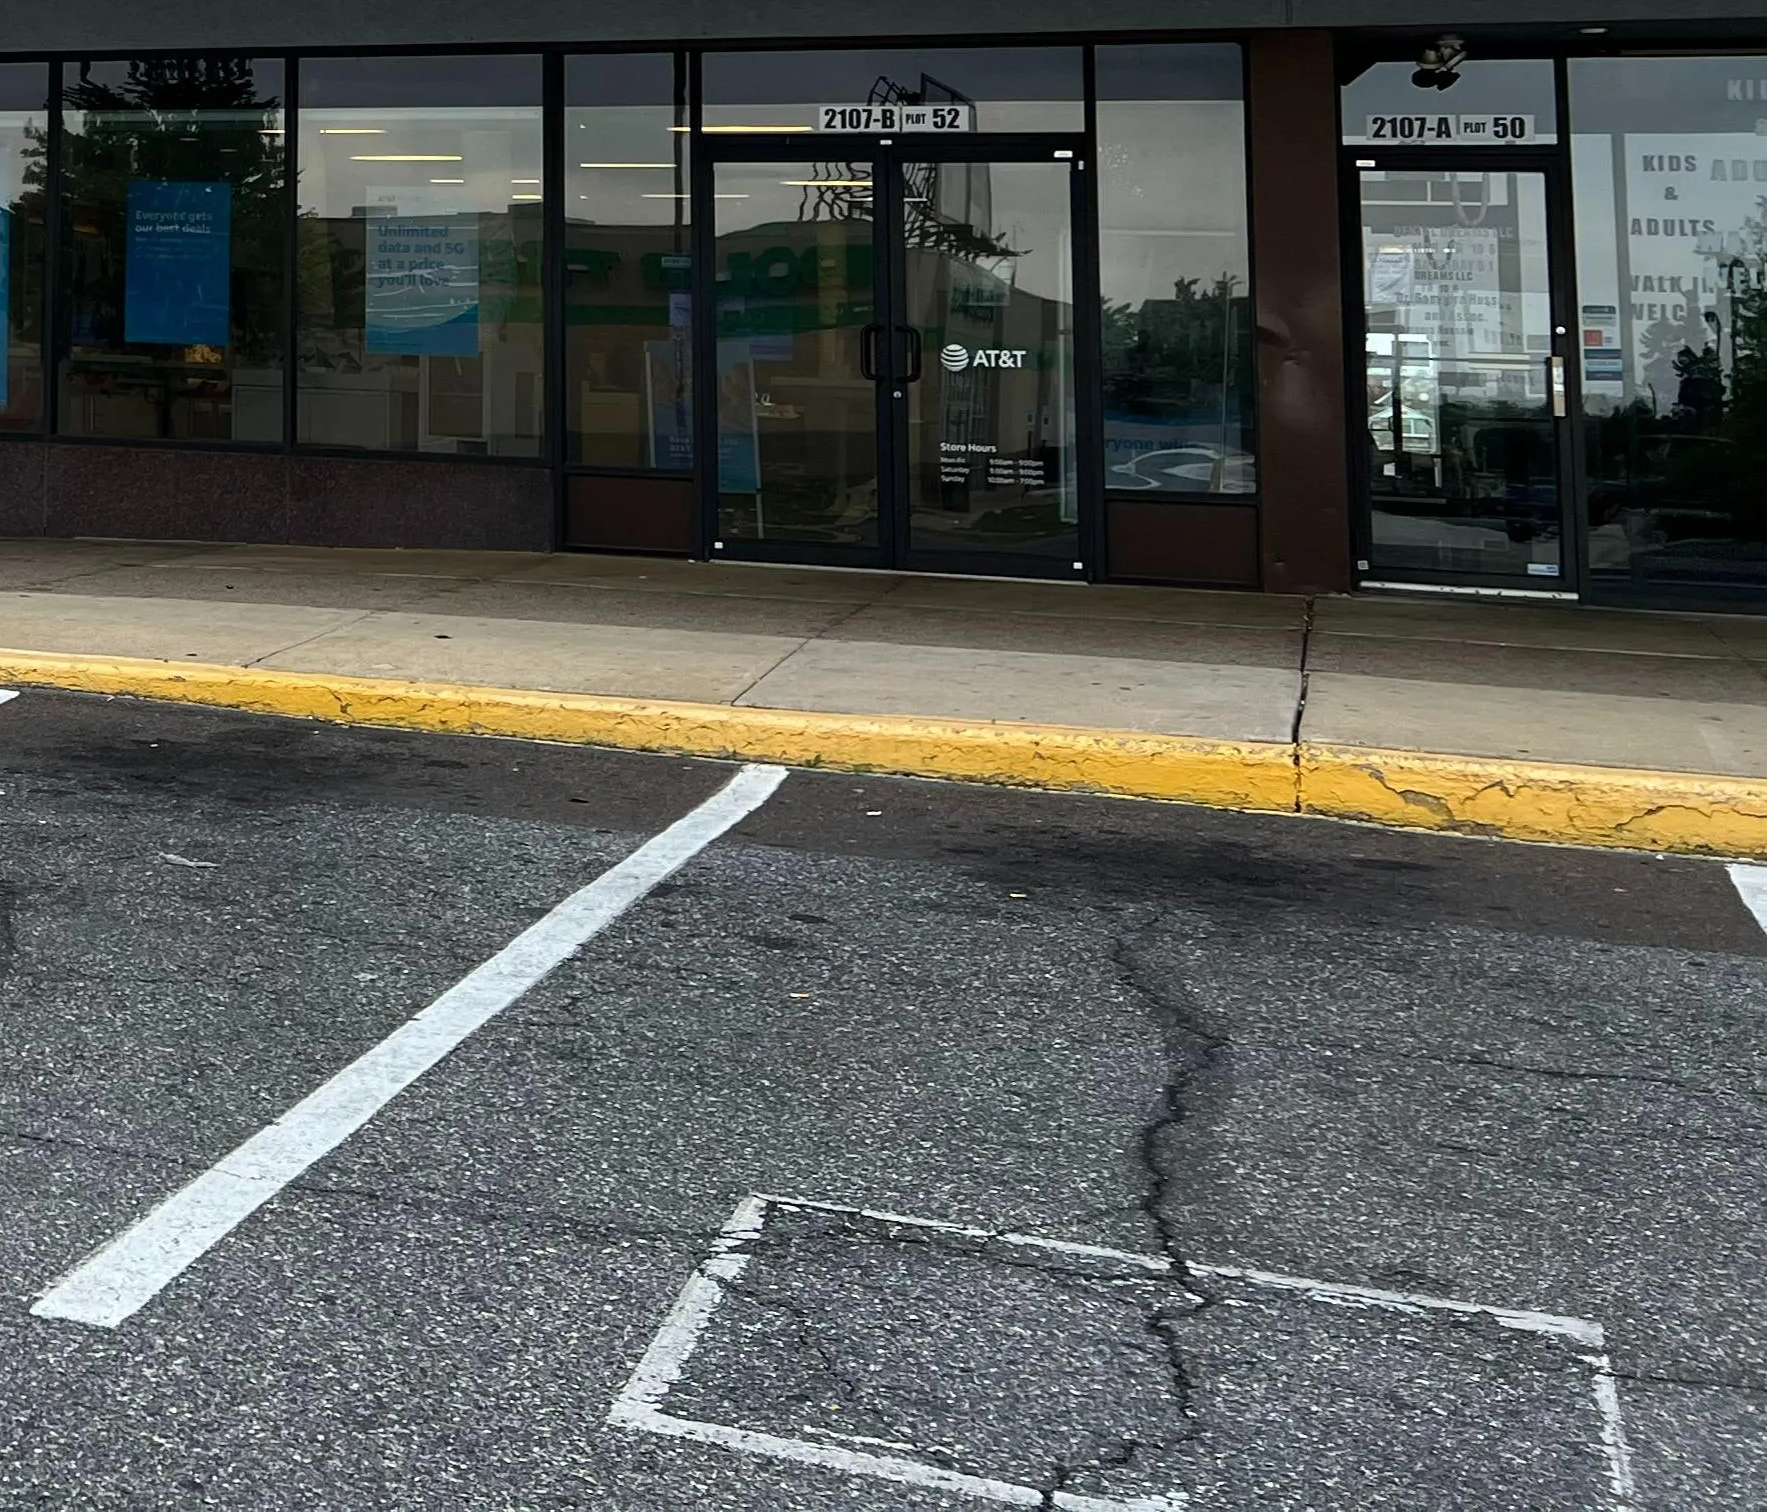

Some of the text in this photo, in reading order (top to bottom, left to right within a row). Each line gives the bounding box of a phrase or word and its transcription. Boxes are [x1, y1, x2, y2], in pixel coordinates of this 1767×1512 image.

[824, 108, 895, 129] 2107-B
[905, 108, 960, 129] PLOT 52
[1371, 116, 1452, 139] 2107-A
[1463, 116, 1525, 139] PLOT 50
[1642, 154, 1698, 172] KIDS
[1664, 186, 1678, 201] &
[135, 210, 213, 223] Everyone gets
[134, 224, 153, 233] our
[377, 224, 449, 238] Unlimited
[1631, 217, 1715, 237] ADULTS
[377, 241, 465, 255] data and 5G
[377, 257, 446, 272] at a price
[377, 274, 416, 289] you'll
[973, 349, 1026, 368] AT&T
[940, 442, 997, 453] Store Hours
[1105, 438, 1154, 451] ryone
